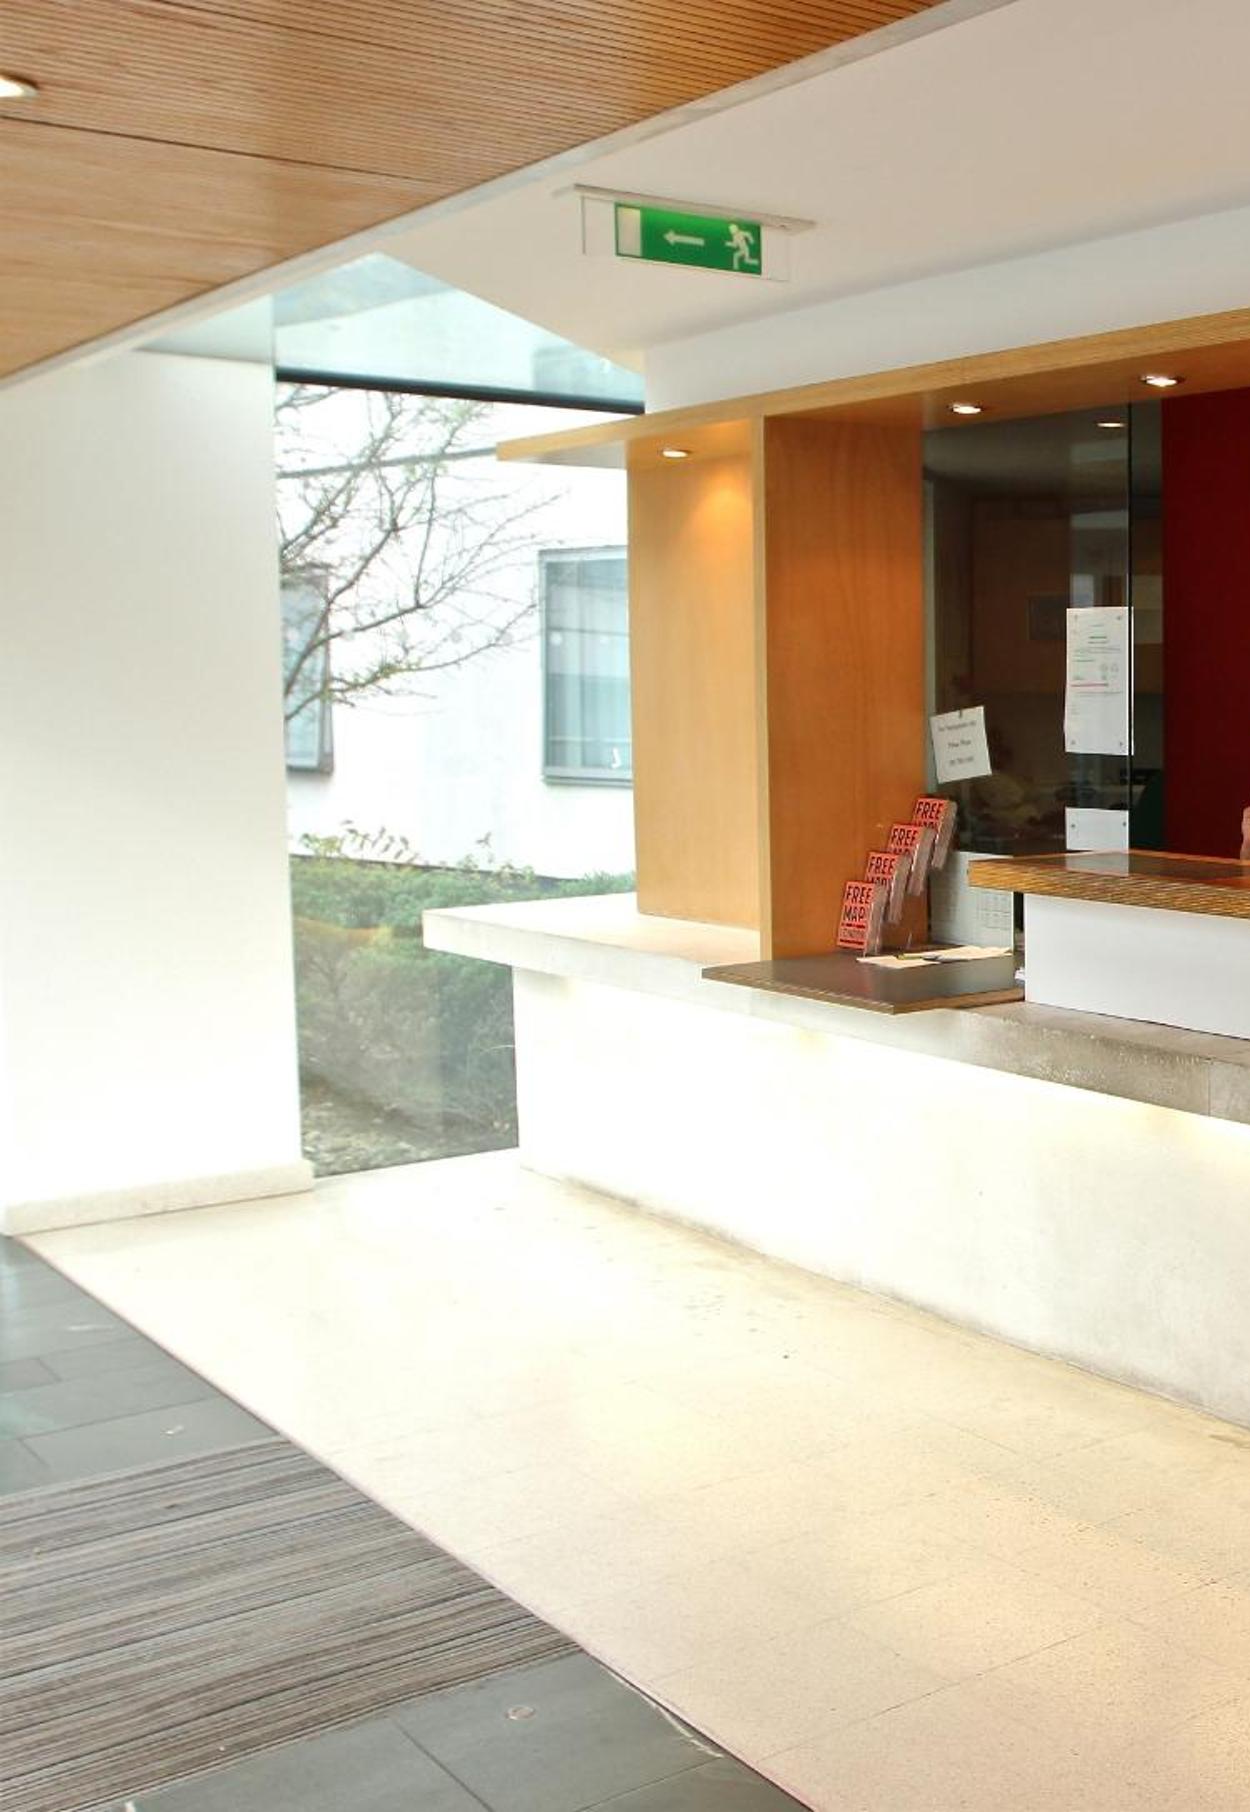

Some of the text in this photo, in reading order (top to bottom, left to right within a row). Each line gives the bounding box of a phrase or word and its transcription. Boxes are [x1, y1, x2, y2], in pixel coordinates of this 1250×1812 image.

[916, 801, 942, 820] FREE
[891, 827, 918, 847] FREE
[868, 855, 896, 875] FREE
[846, 885, 874, 905] FREE
[843, 904, 867, 923] MAP
